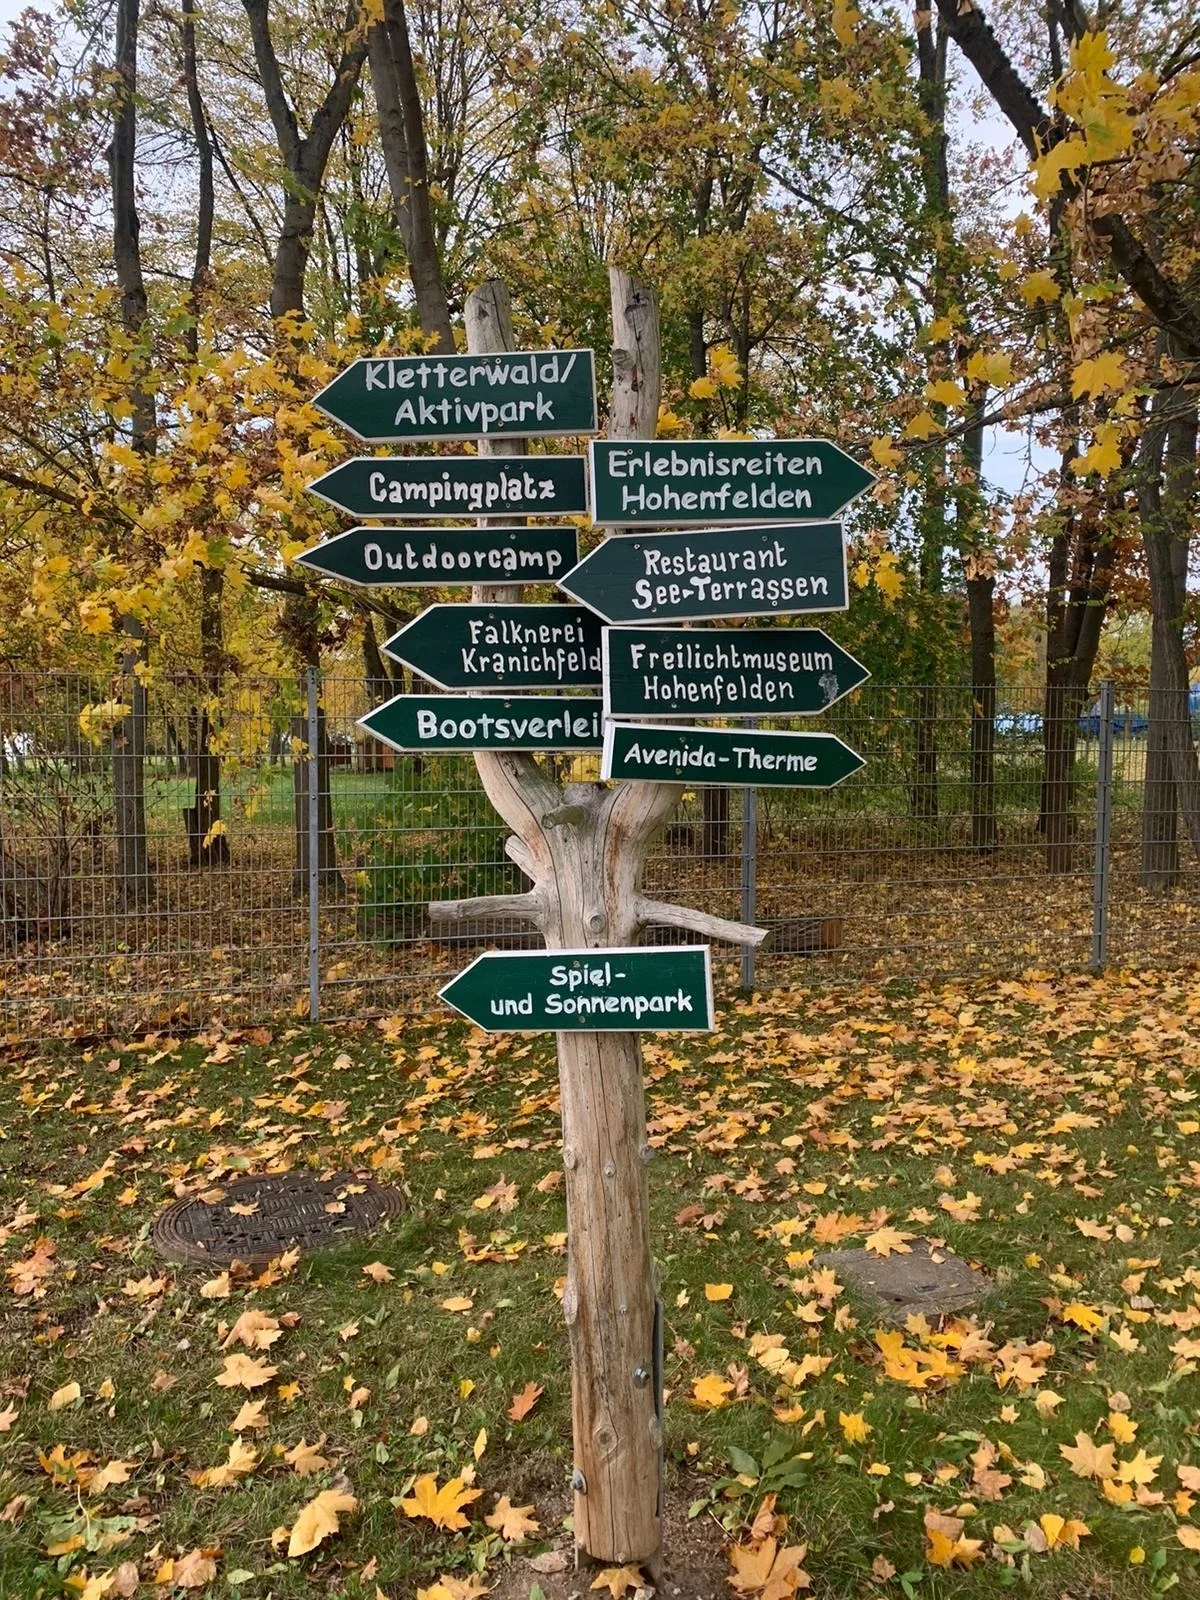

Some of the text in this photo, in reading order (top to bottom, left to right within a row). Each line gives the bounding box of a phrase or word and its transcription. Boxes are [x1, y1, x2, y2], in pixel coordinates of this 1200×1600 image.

[365, 353, 577, 391] Kletterwald/
[394, 391, 555, 433] Aktivpark
[608, 449, 823, 478] Erlebnisreiten
[368, 471, 556, 511] Campingplatz
[622, 482, 812, 512] Hohenfelden
[364, 542, 562, 575] Outdoorcamp
[643, 541, 788, 576] Restaurant
[631, 575, 829, 610] See-Terrassen
[468, 617, 585, 645] Falknerei
[461, 647, 602, 681] Kranichfeld
[630, 643, 834, 673] Freilichtmuseum
[643, 673, 795, 705] Hohenfelden
[416, 710, 605, 740] Bootsverlei
[623, 743, 818, 773] Avenida-Therme
[549, 962, 626, 992] Spiel-
[490, 989, 693, 1020] und Sonnenpark
